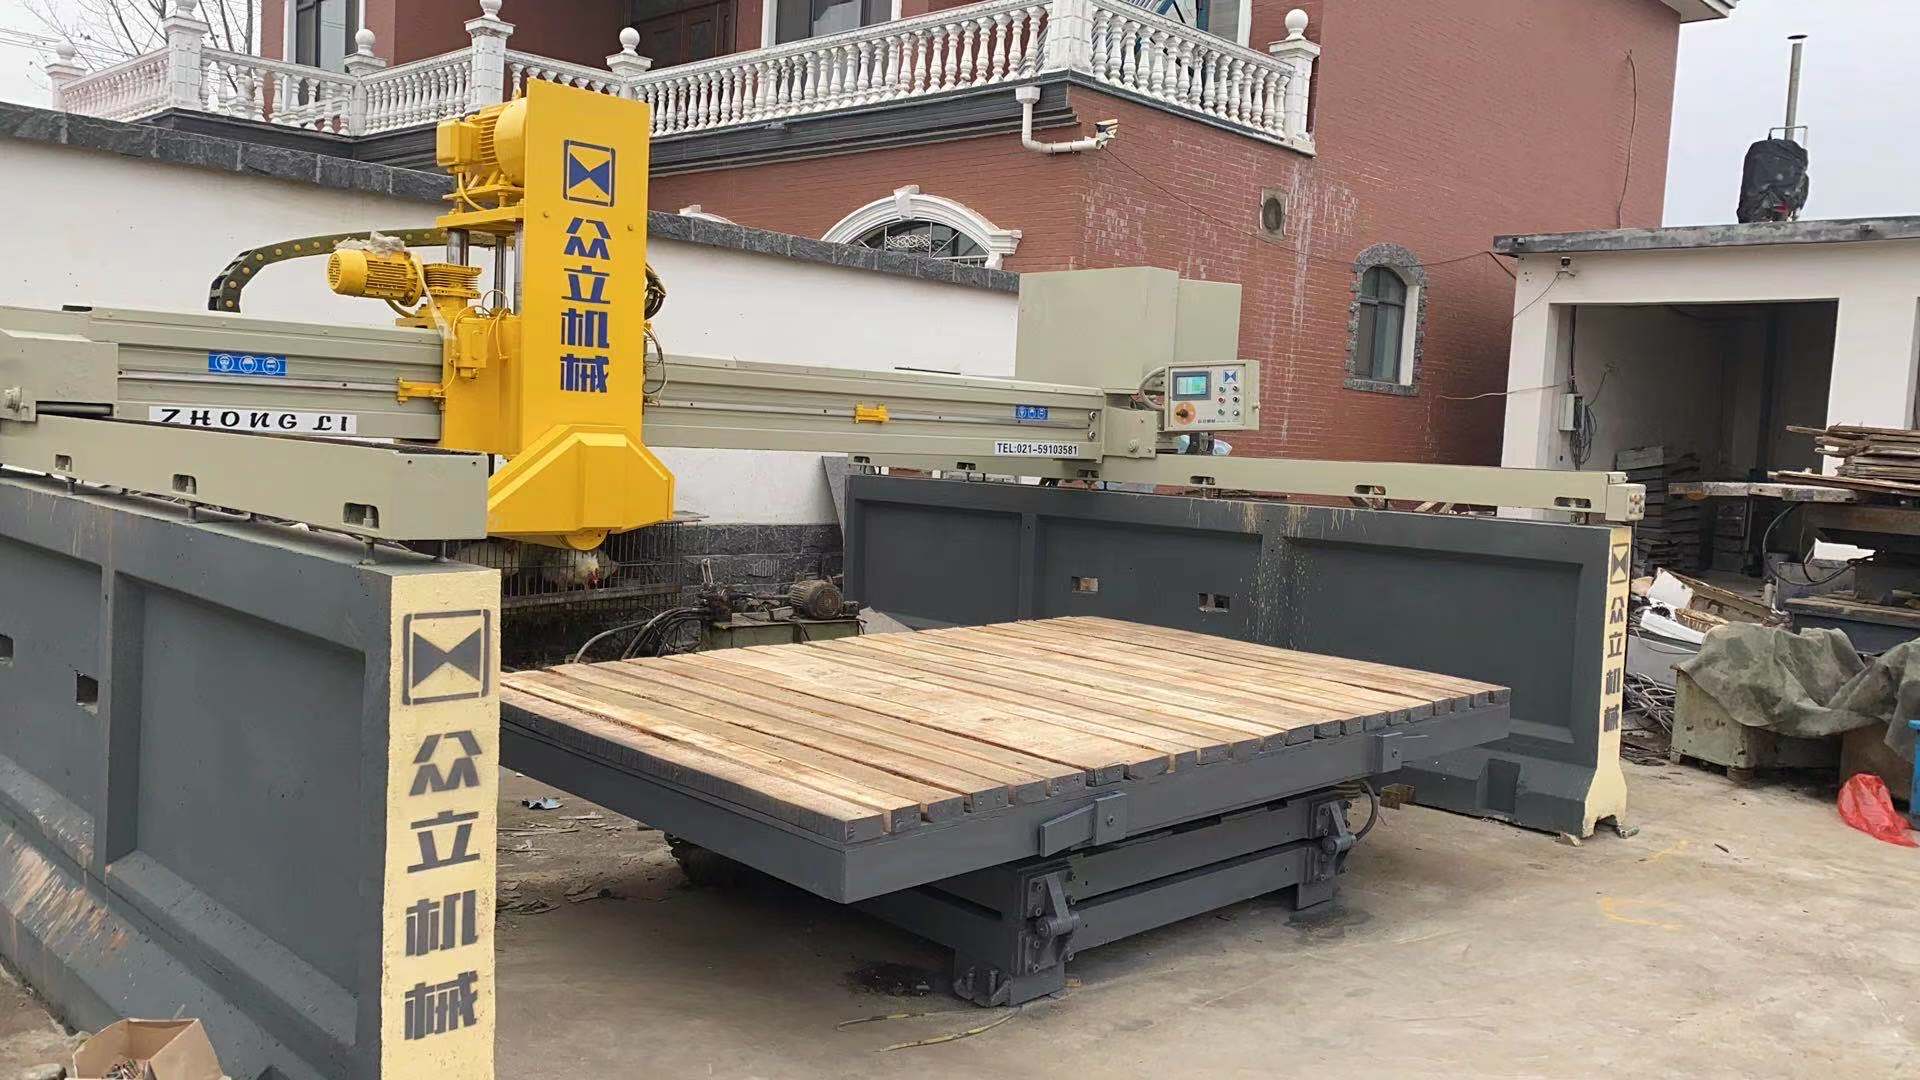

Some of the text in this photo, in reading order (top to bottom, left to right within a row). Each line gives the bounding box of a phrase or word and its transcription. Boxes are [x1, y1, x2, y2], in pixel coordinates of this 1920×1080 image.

[560, 217, 612, 393] 众立机械
[312, 415, 348, 432] LI
[997, 443, 1077, 455] TEL:021-59103581
[1604, 596, 1625, 732] 众立机械
[404, 730, 482, 1040] 众立机械
